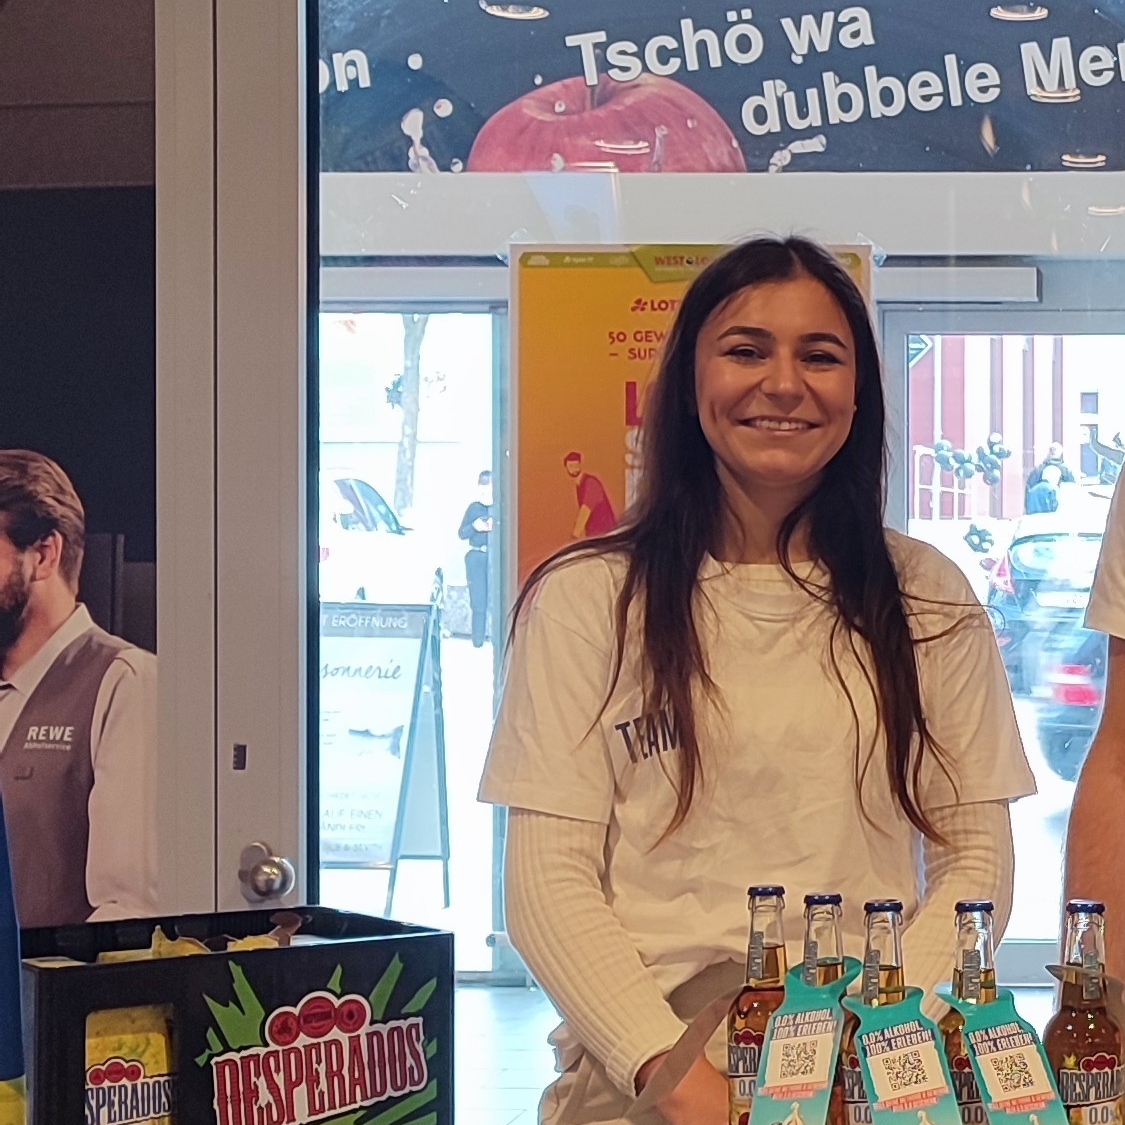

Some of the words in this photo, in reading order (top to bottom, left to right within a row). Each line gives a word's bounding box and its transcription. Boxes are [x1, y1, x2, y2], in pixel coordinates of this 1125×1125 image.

[564, 8, 765, 87] Tschö
[779, 5, 876, 55] wa
[740, 53, 1002, 136] dubbele
[608, 331, 628, 346] 50
[331, 612, 409, 629] ERÖFFNUNG
[27, 725, 75, 742] REWE
[891, 1029, 933, 1052] ERLEBEN!
